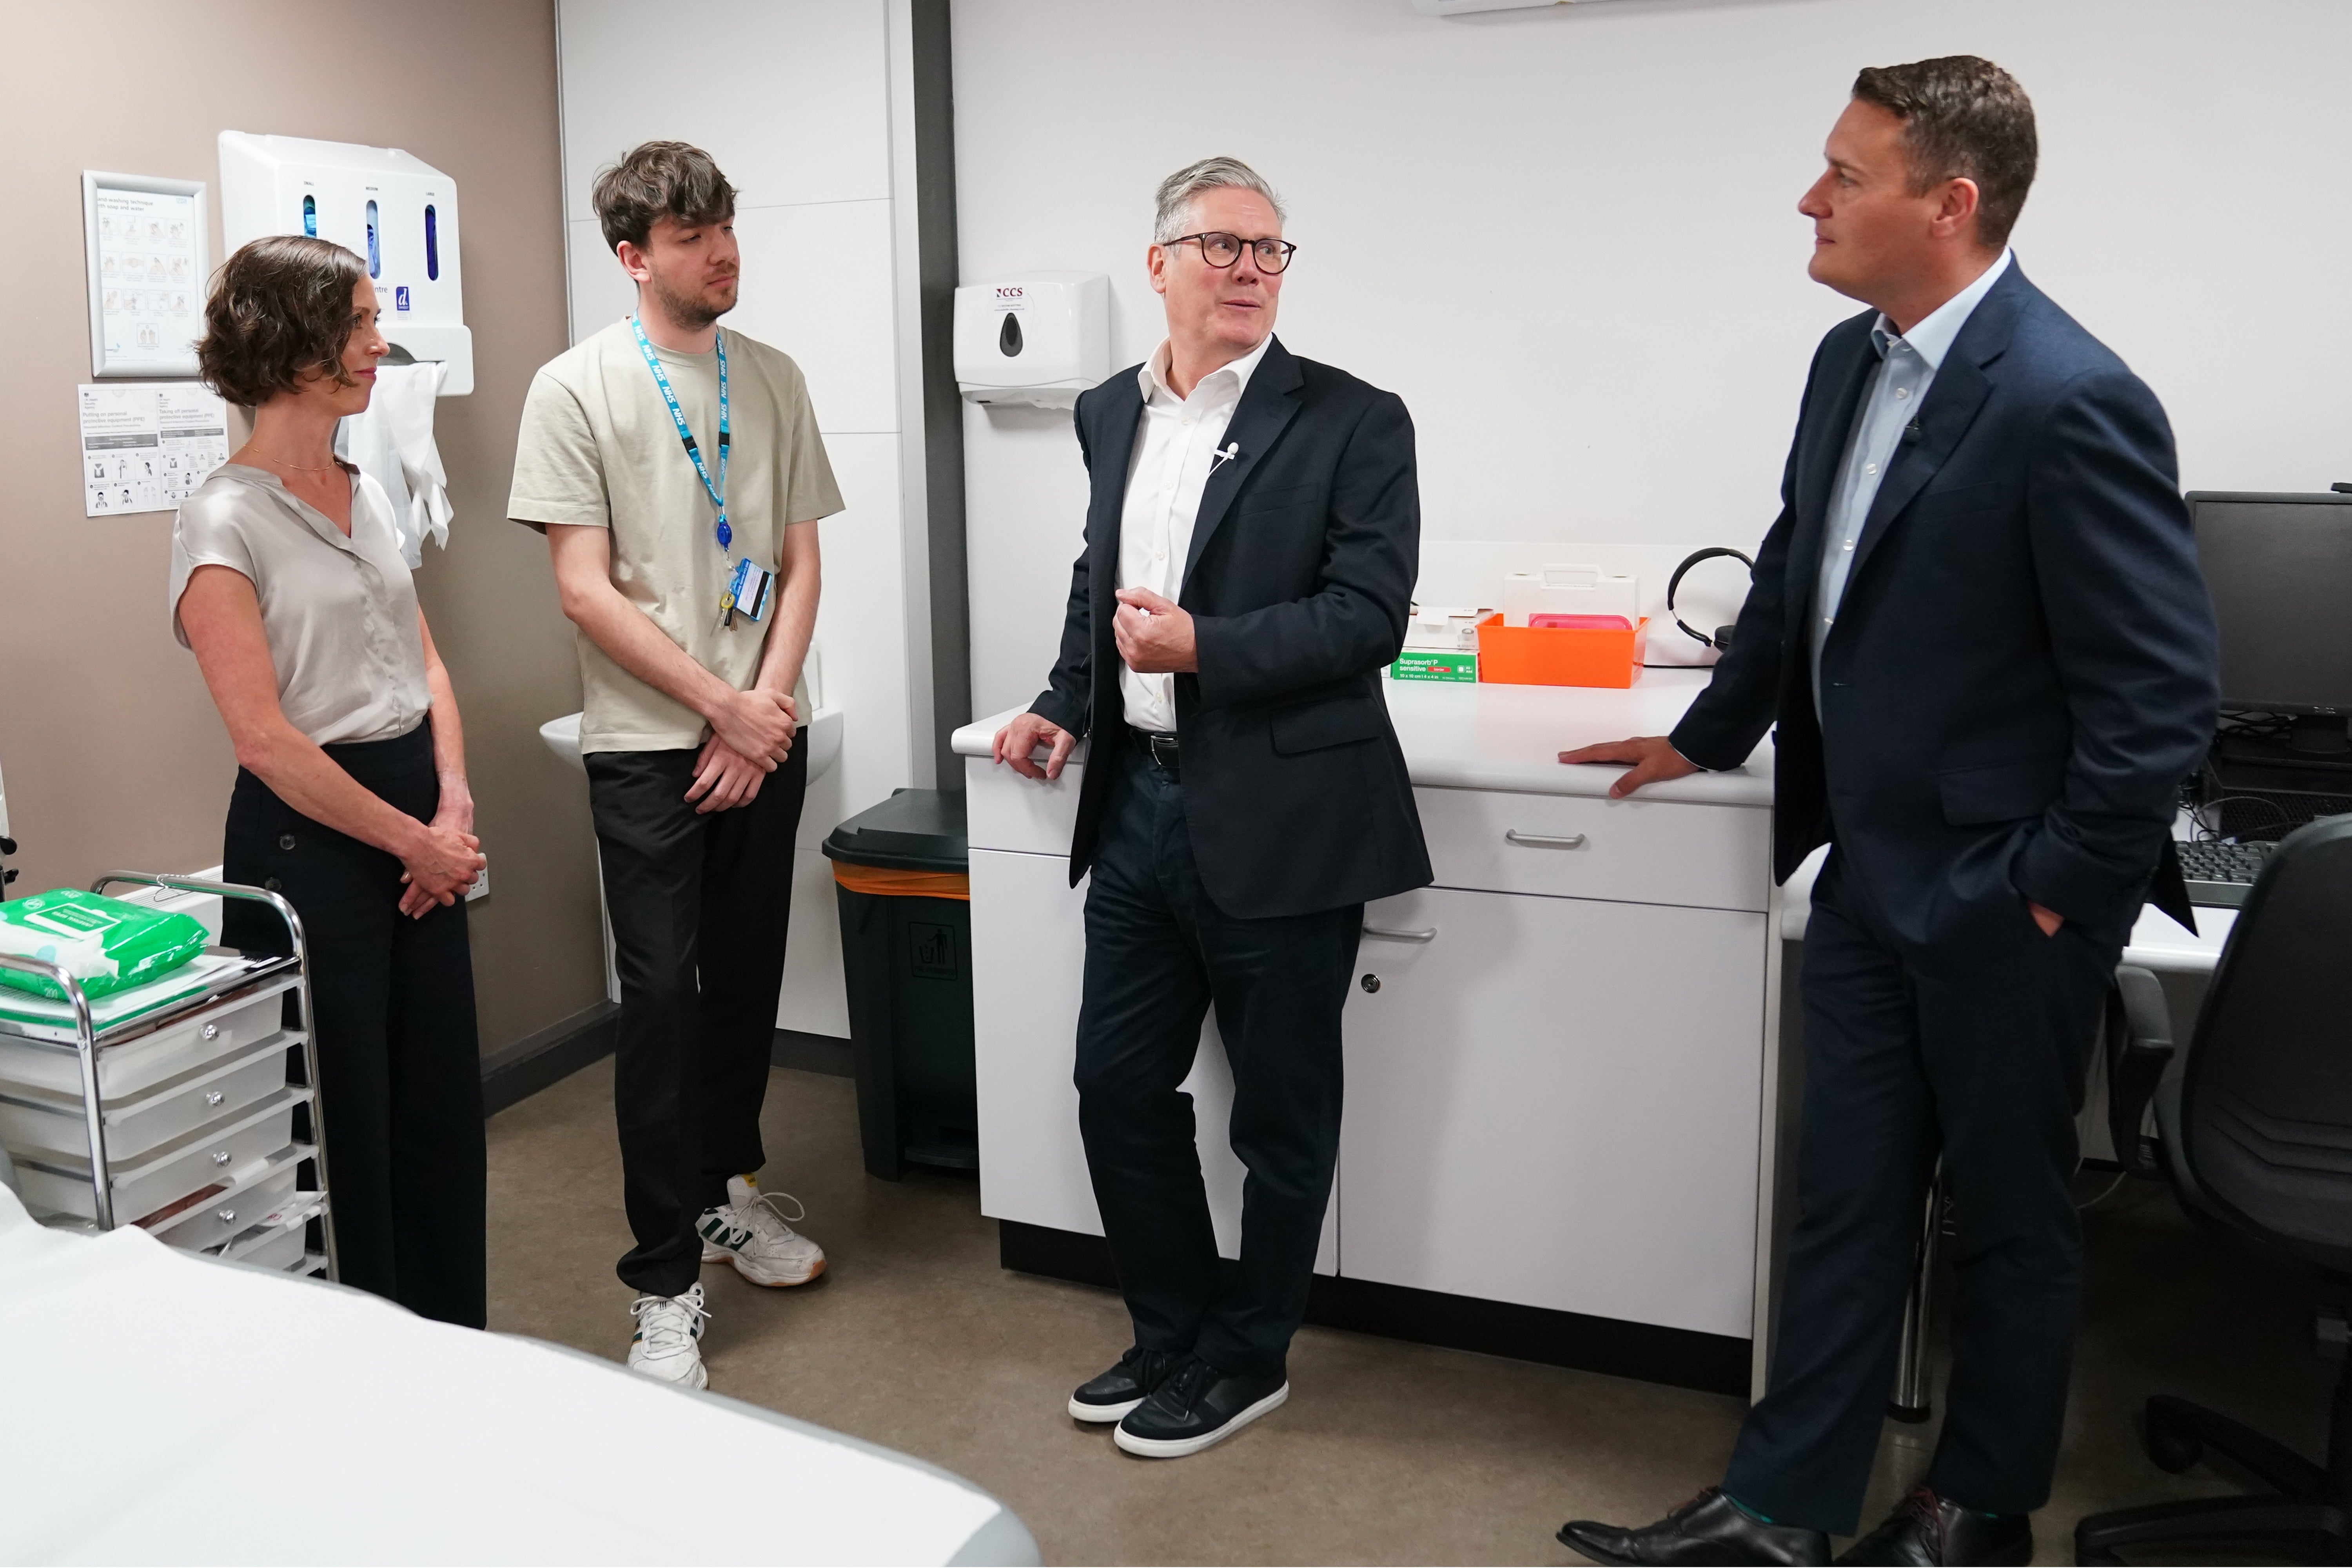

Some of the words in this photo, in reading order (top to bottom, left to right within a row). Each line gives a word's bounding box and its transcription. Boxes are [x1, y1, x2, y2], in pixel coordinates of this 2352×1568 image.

[1003, 287, 1023, 297] CCS
[634, 325, 646, 341] NHS
[642, 345, 656, 361] NHS
[652, 365, 666, 381] NHS
[662, 386, 676, 403] NHS
[672, 408, 686, 426] NHS
[697, 462, 709, 479] NHS
